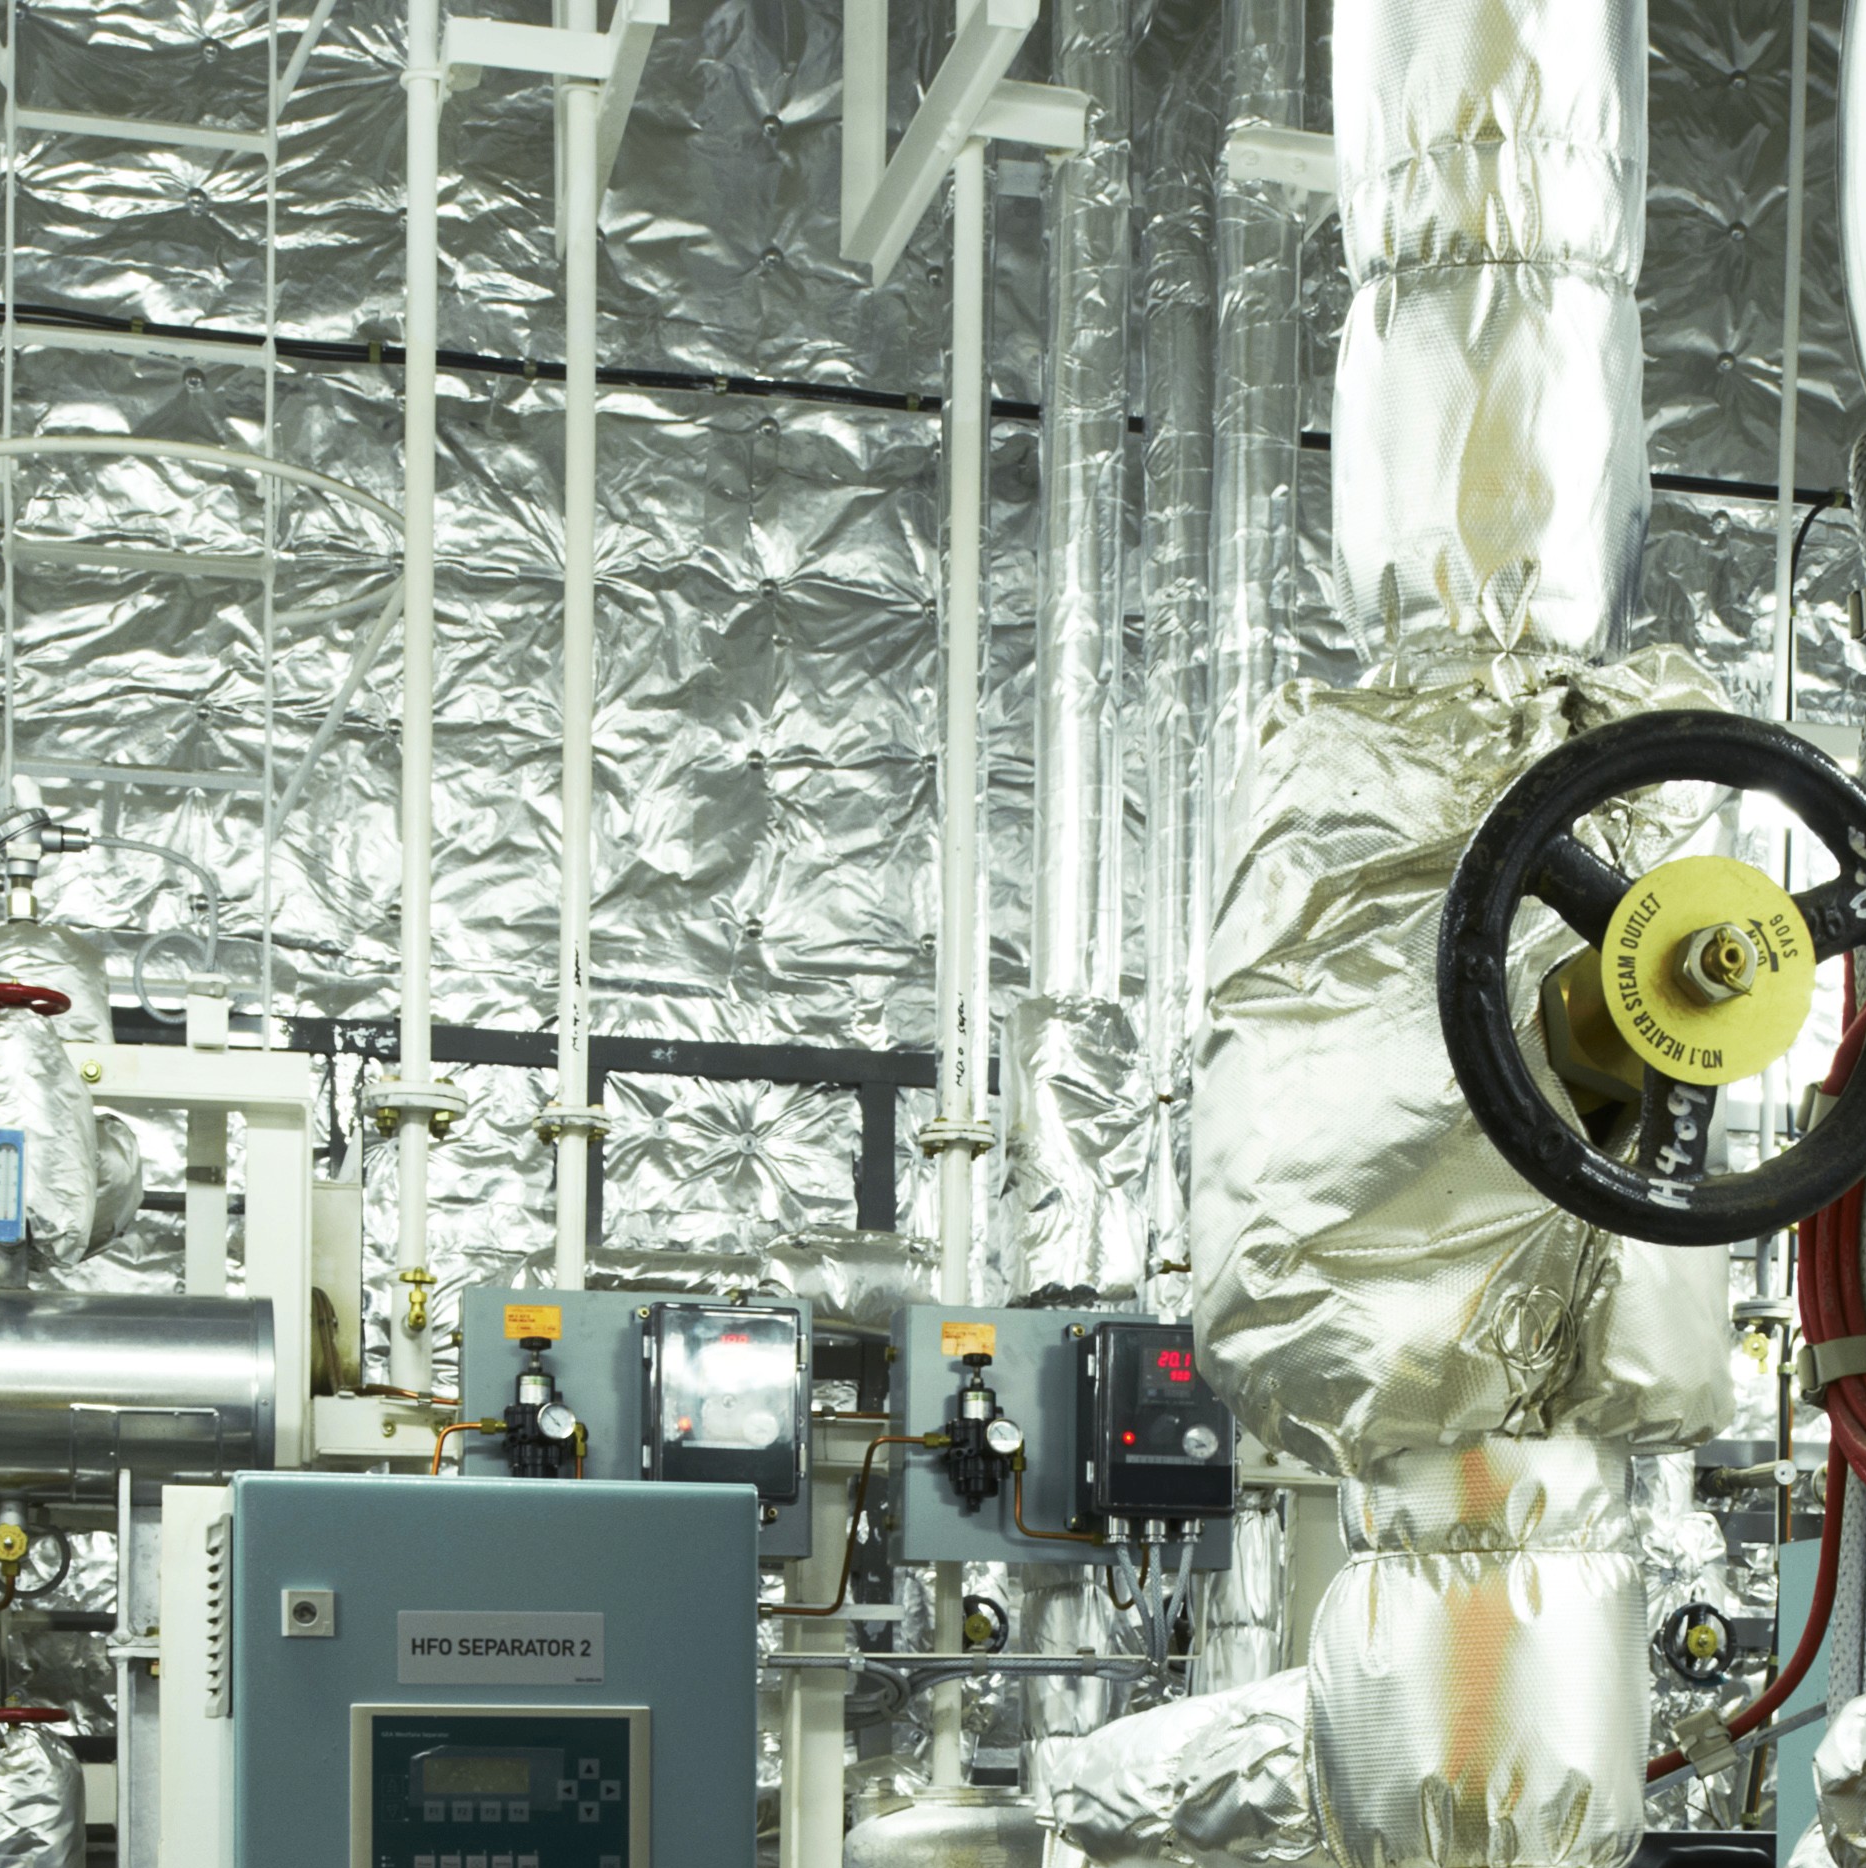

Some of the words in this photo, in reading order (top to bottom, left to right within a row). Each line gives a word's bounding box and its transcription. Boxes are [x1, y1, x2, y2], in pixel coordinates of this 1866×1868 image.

[1621, 892, 1661, 949] OUTLET
[1770, 914, 1798, 959] SV06
[1618, 955, 1642, 1012] STEAM
[1633, 1011, 1685, 1062] HEATER
[1688, 1047, 1723, 1069] NO.1
[1157, 1350, 1192, 1368] 20.1
[411, 1638, 452, 1656] HFO
[458, 1638, 575, 1657] SEPARATOR
[580, 1640, 591, 1657] 2
